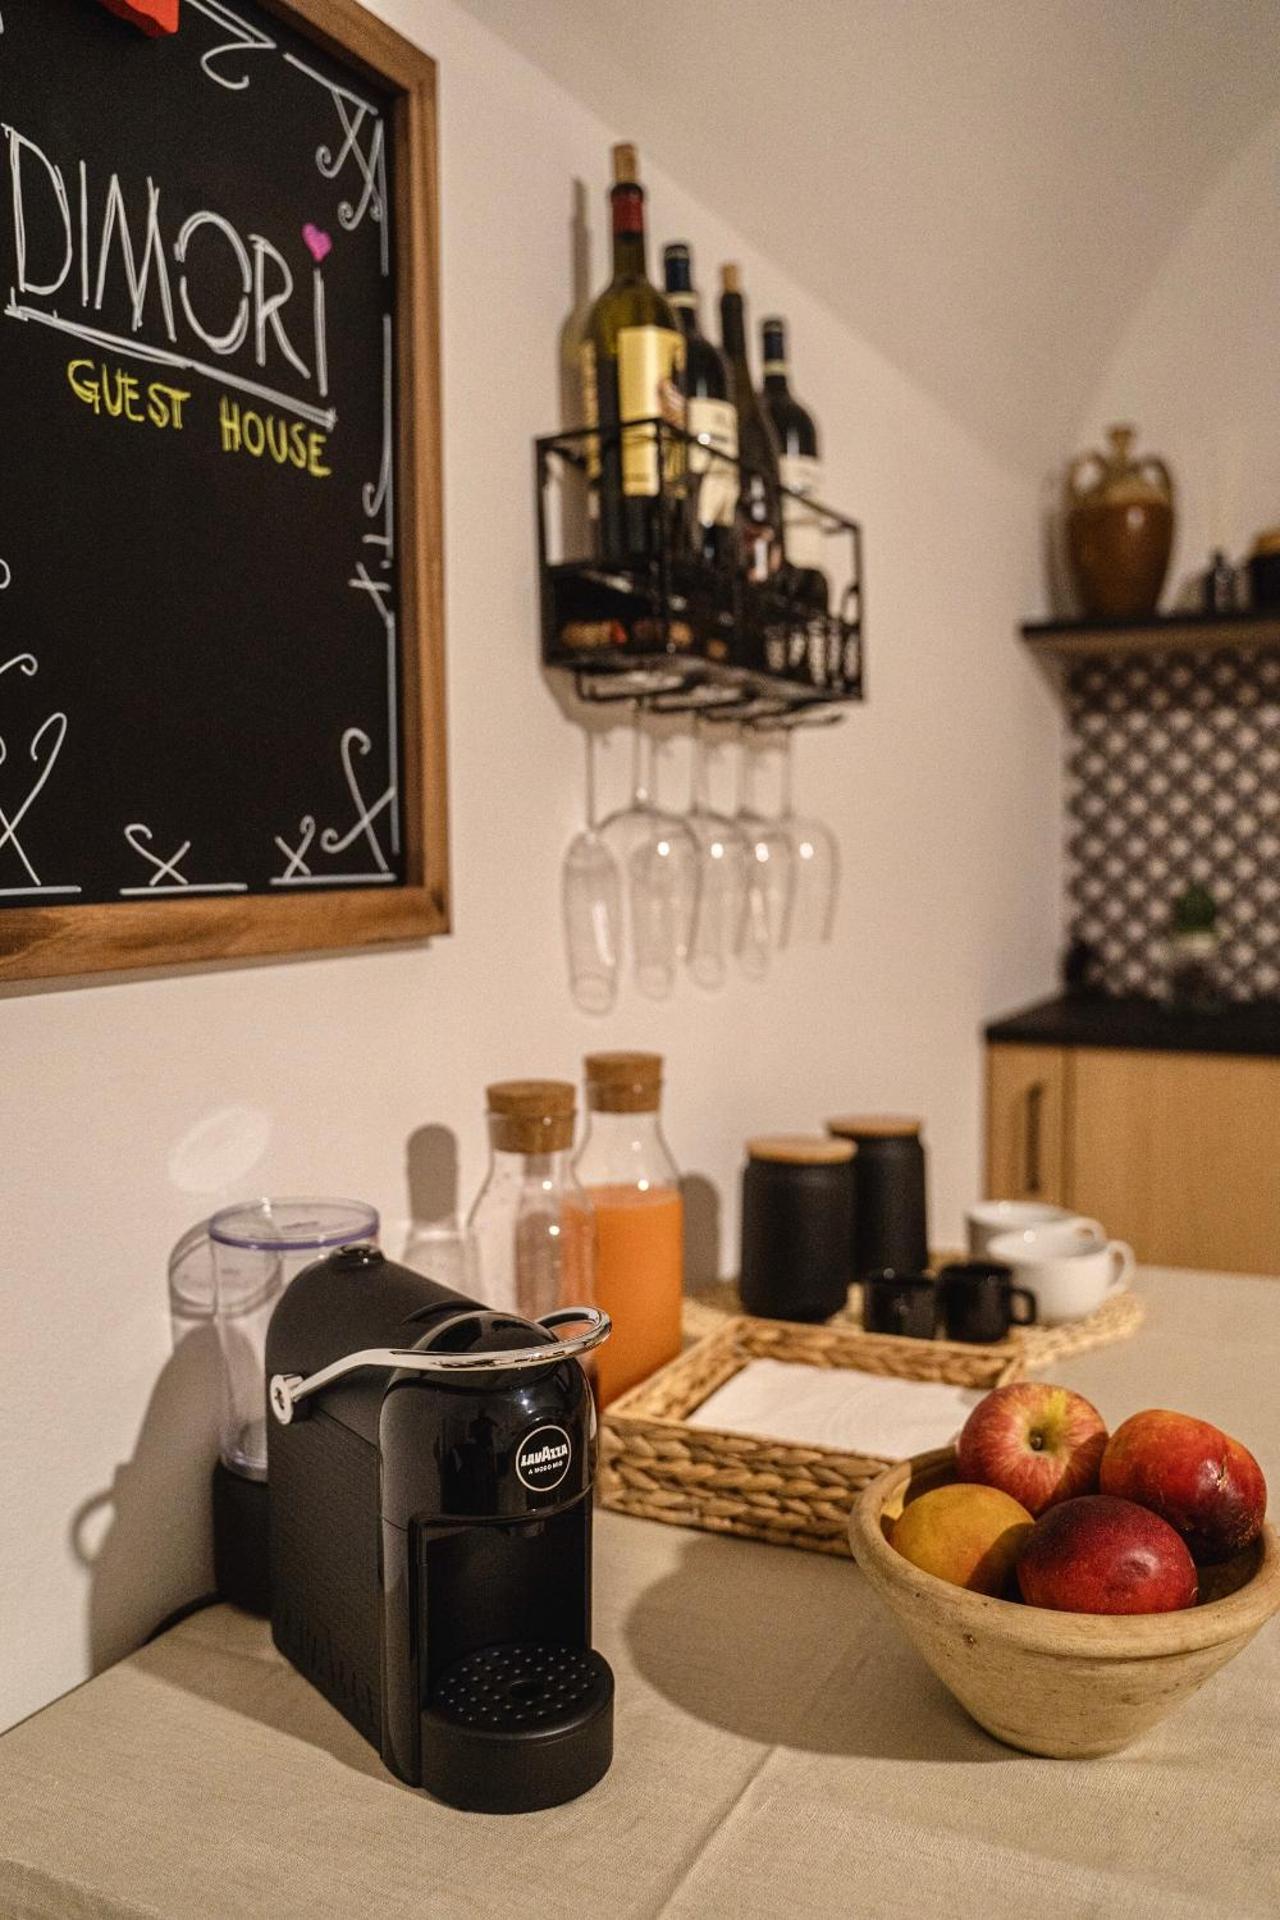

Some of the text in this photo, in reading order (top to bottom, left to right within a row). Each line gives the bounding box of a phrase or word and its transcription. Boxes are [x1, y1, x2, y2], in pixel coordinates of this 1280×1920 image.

[68, 360, 331, 477] GUEST HOUSE
[520, 1444, 568, 1467] LAVAZZA
